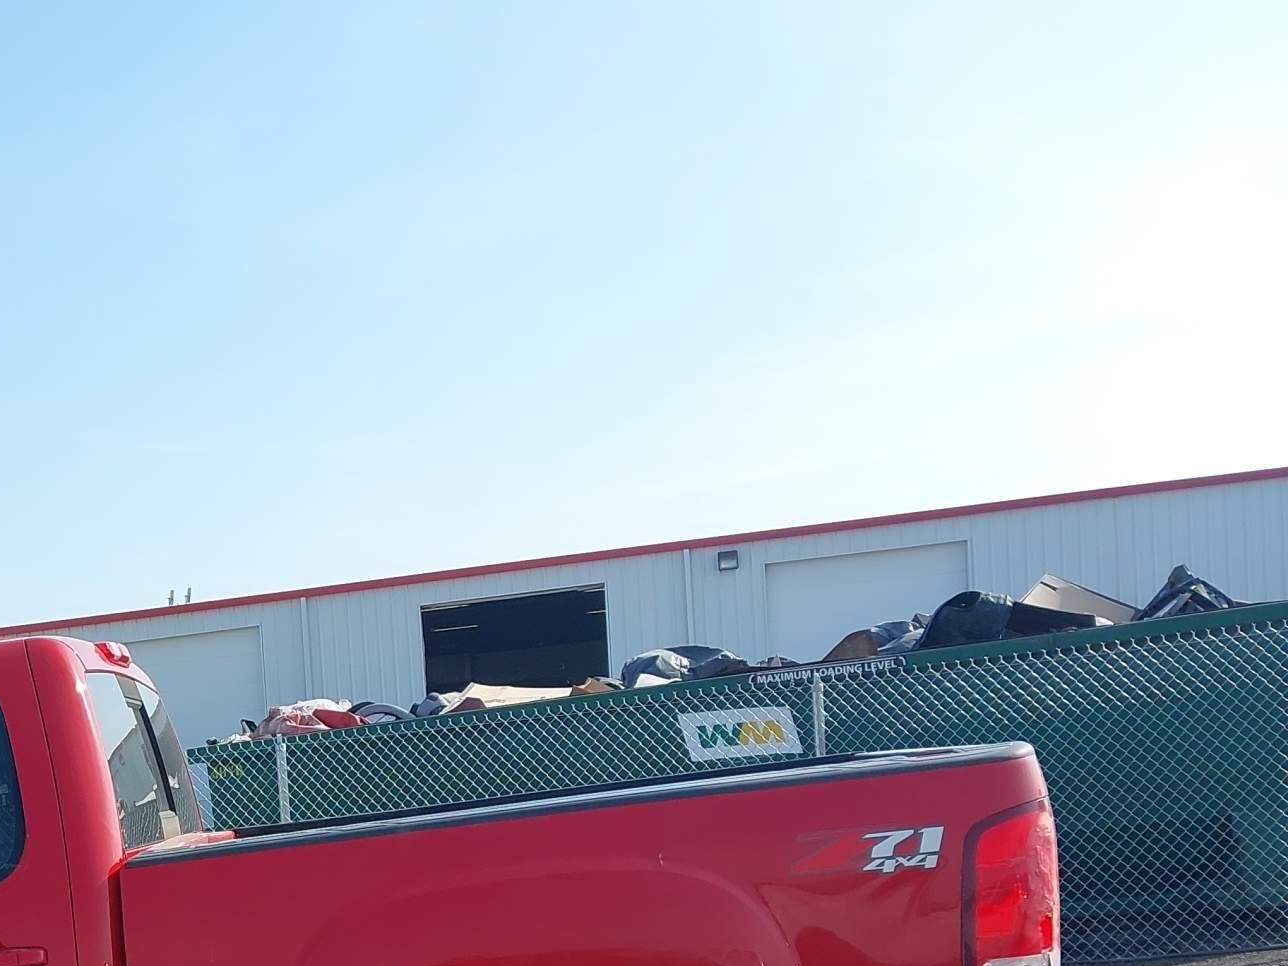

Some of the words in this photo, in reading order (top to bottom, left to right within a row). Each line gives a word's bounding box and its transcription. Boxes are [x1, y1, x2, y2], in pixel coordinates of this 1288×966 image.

[757, 669, 812, 684] MAXIMUM
[864, 659, 898, 672] LEVEL
[697, 720, 784, 748] WM
